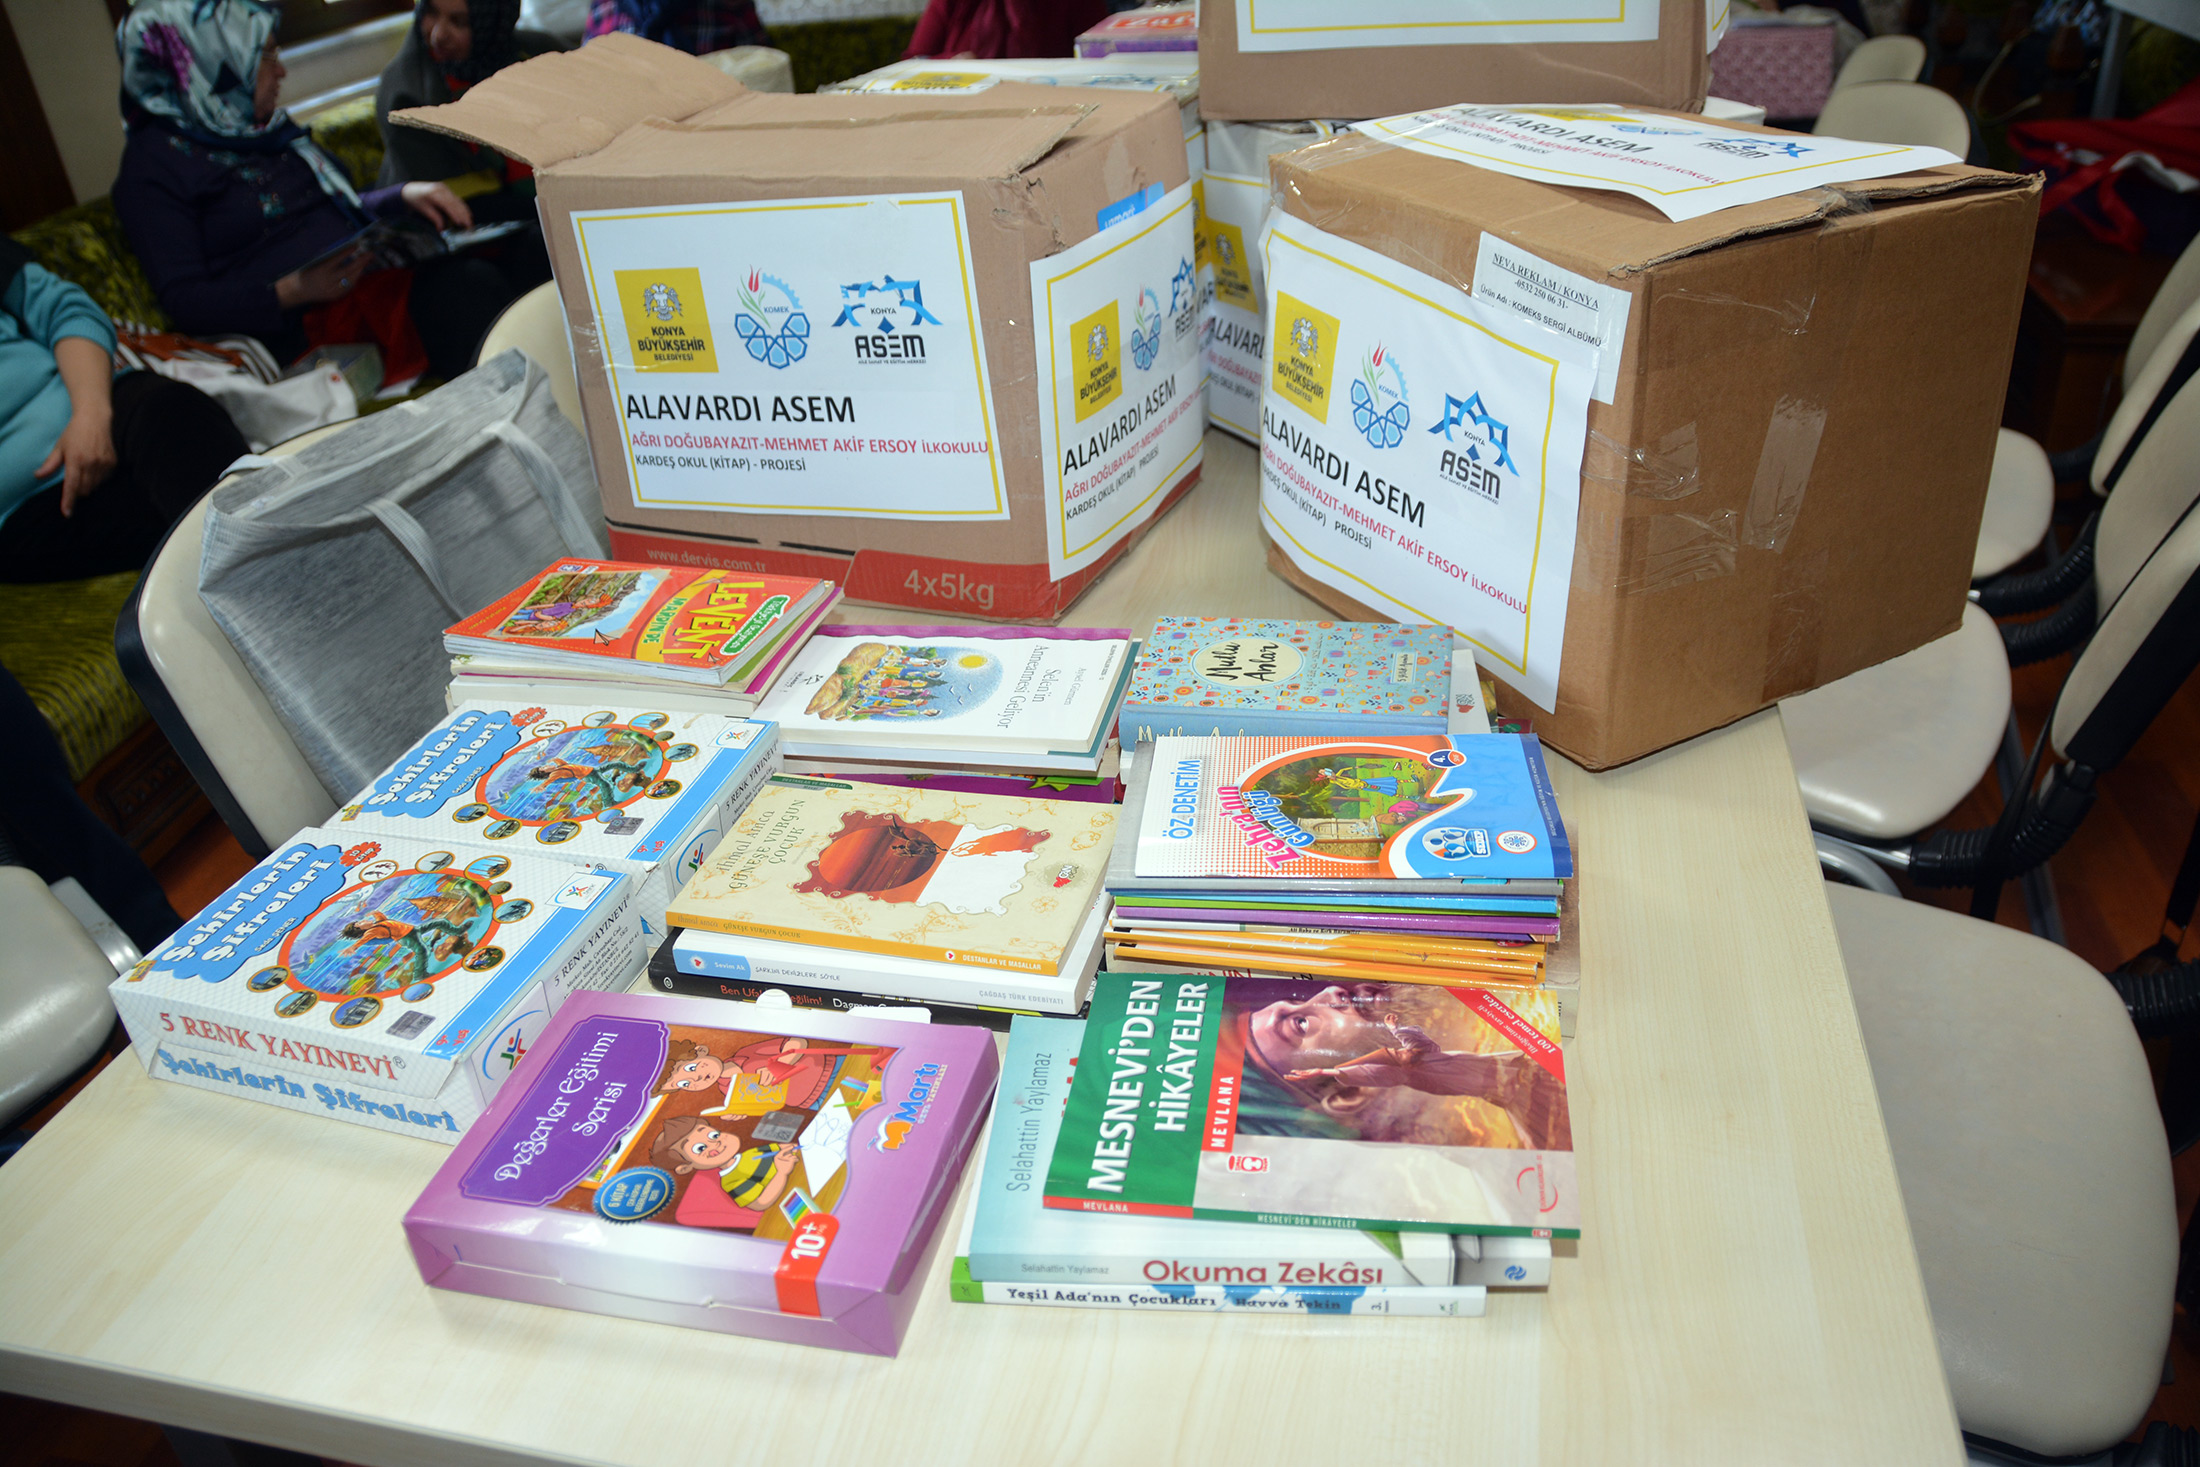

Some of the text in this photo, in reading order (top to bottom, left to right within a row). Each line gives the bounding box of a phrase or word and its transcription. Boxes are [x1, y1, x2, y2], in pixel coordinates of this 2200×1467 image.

[1570, 133, 1654, 154] ASEM
[1493, 252, 1517, 271] NEVA
[1517, 265, 1557, 291] REKLAM
[1563, 286, 1599, 310] KONYA
[1514, 278, 1533, 294] -0532
[1534, 288, 1547, 300] 250
[1547, 294, 1556, 305] 06
[763, 306, 790, 314] KOMEK
[870, 307, 897, 315] KONYA
[1480, 284, 1602, 348] Ürün Adı KOMEKS SERGİ ALBÜMÜ
[637, 338, 706, 353] BÜYÜKŞEHİR
[651, 326, 685, 337] KONYA
[854, 335, 926, 359] ASEM
[654, 352, 694, 362] BELEDİYESİ
[1090, 360, 1109, 380] KONYA
[1290, 354, 1314, 378] KONYA
[1080, 367, 1118, 400] BÜYÜKŞEHİR
[1277, 361, 1325, 400] BÜYÜKŞEHİR
[1378, 383, 1399, 400] KOMEK
[626, 394, 856, 423] ALAVARDI ASEM
[1063, 374, 1177, 476] ALAVARDI ASEM
[631, 432, 989, 455] AĞRI DOĞUBAYAZIT-MEHMET AKİF ERSOY İLKOKULU
[1463, 430, 1486, 447] KONYA
[635, 454, 806, 472] KARDEŞ OKUL (KİTAP) PROJESİ
[1263, 405, 1425, 529] ALAVARDI ASEM
[1440, 449, 1501, 500] ASEM
[1065, 481, 1090, 503] AĞRI
[1066, 497, 1097, 520] KARDEŞ
[1098, 485, 1115, 503] OKUL
[1276, 453, 1528, 615] DOĞUBAYAZIT-MEHMET AKİF ERSOY İLKOKULU
[1281, 481, 1373, 550] OKUL (KİTAP) PROJESİ
[646, 547, 767, 574] www.dervis.com.tr
[904, 569, 995, 610] 4x5kg
[659, 581, 766, 659] LEVENT
[1073, 667, 1087, 683] Aysel
[1205, 641, 1243, 681] Mutlu
[1243, 641, 1280, 683] Anlar
[997, 644, 1050, 729] Anneannesi Geliyor
[367, 715, 482, 806] Şehirlerin
[404, 721, 508, 804] Şifreleri
[1432, 754, 1446, 763] 4.
[1161, 759, 1201, 840] ÖZ DENETİM
[1216, 785, 1301, 870] Zehra'nın
[1241, 789, 1316, 848] Günlüğü
[349, 849, 361, 857] 10
[728, 798, 806, 890] GÜNEŞE VURGUN
[768, 827, 805, 865] ÇOCUK
[160, 850, 311, 962] Şehirlerin
[201, 858, 336, 962] Şifreleri
[254, 916, 299, 953] Seda ŞENER
[553, 895, 630, 988] 5 RENK YAYINEVİ
[722, 921, 801, 939] GÜNEŞE VURGUN ÇOCUK
[714, 960, 746, 972] Sevim Ak
[819, 972, 841, 982] SÖYLE
[962, 953, 1042, 971] DESTANLAR VE MASALLAR
[719, 984, 823, 1006] Ben eğilim!
[978, 989, 1064, 1005] ÇAĞDAŞ TÜRK EDEBİYATI
[1482, 992, 1557, 1055] 100 temel eserden
[159, 1013, 398, 1081] 5 RENK YAYINEVİ
[1147, 982, 1210, 1133] HİKÂYELER
[157, 1047, 461, 1133] Şehirlerin Şifreleri
[892, 1062, 940, 1123] Martı
[1086, 980, 1165, 1195] MESNEVİ'DEN
[493, 1031, 620, 1182] Değerler Eğitimi
[571, 1081, 628, 1137] Serisi
[1005, 1051, 1053, 1192] Selahattin Yaylamaz
[1210, 1075, 1235, 1149] MEVLANA
[609, 1182, 628, 1203] KİTAP
[1082, 1200, 1129, 1213] MEVLANA
[1256, 1213, 1311, 1227] MESNEVİ'DEN
[790, 1221, 827, 1260] 10+
[1020, 1259, 1383, 1285] Selahattin Yaylamaz Okuma Zekâsı
[1006, 1287, 1290, 1310] Yeşil Ada'nın Çocukları Havva
